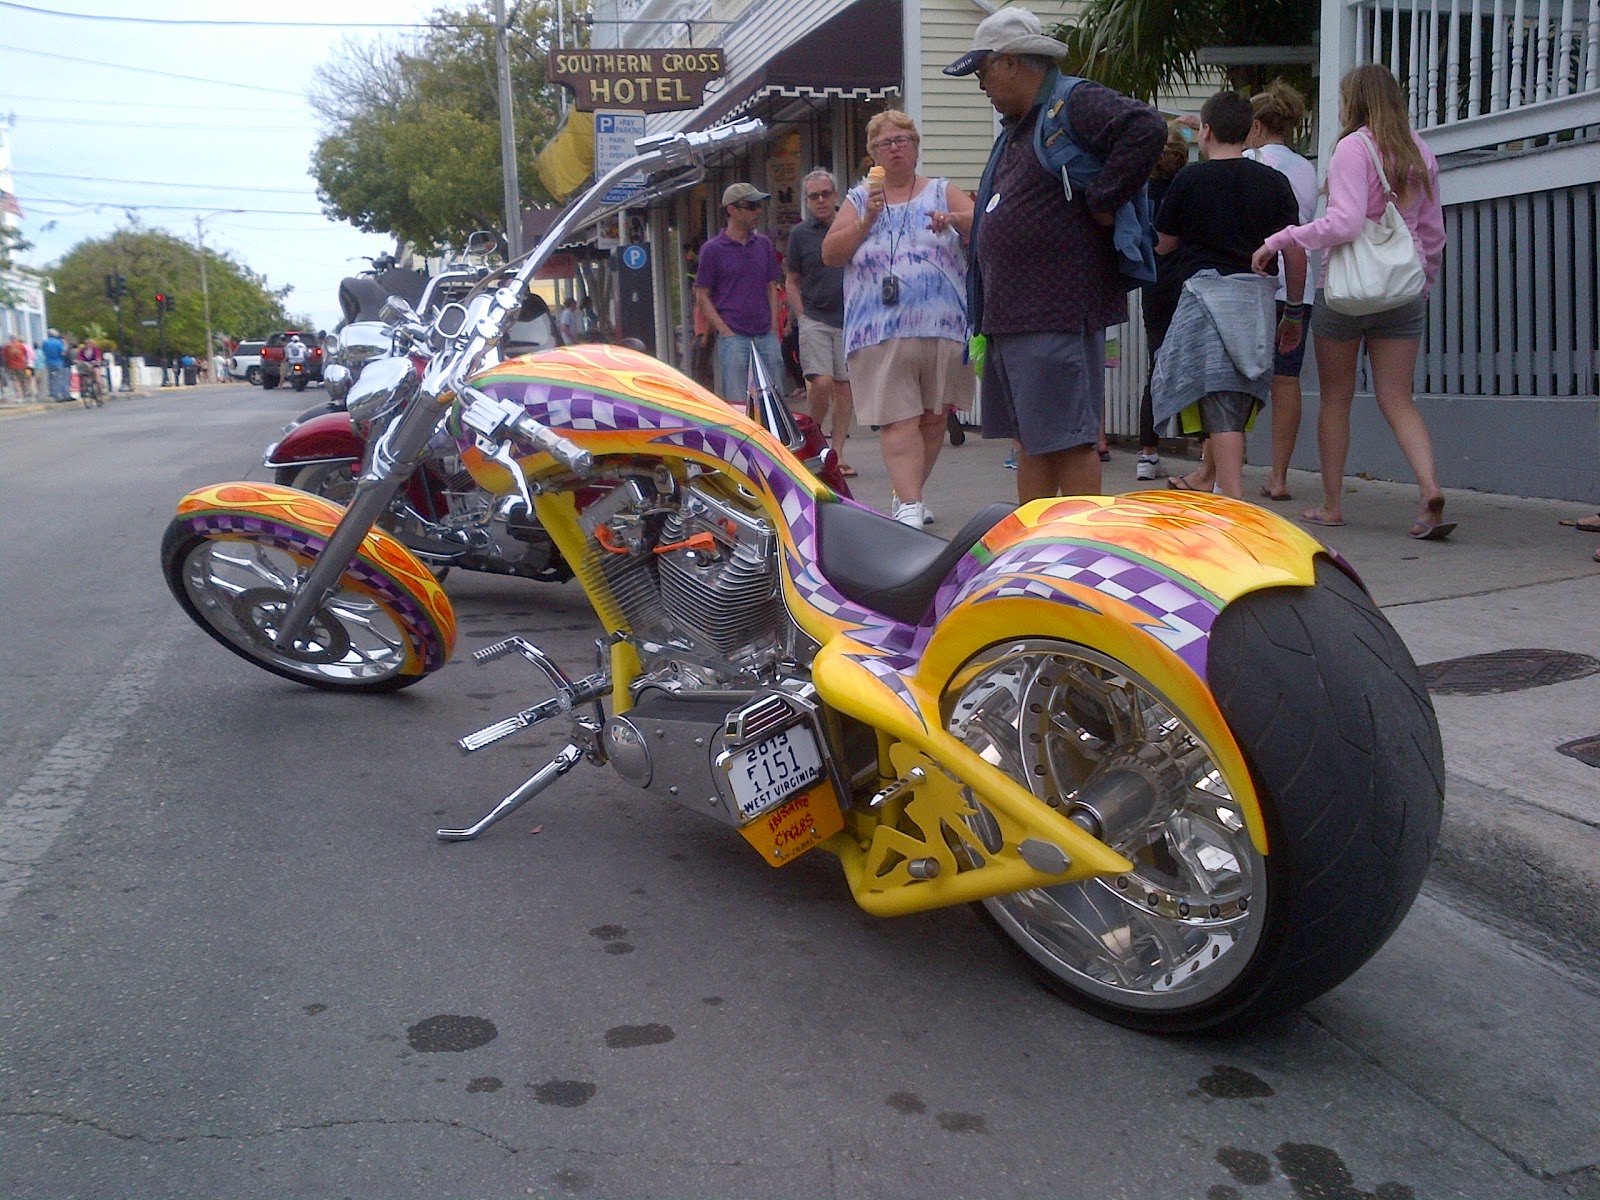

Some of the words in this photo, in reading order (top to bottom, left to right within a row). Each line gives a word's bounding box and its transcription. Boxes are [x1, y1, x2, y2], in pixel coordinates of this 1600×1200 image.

[556, 54, 652, 73] SOUTHERN
[662, 53, 720, 72] CROSS
[590, 78, 692, 104] HOTEL
[600, 117, 613, 132] P
[615, 126, 643, 134] PARKING
[629, 249, 641, 265] P
[746, 732, 789, 762] 2013
[744, 793, 772, 813] WEST
[775, 767, 817, 796] VIRGINIA
